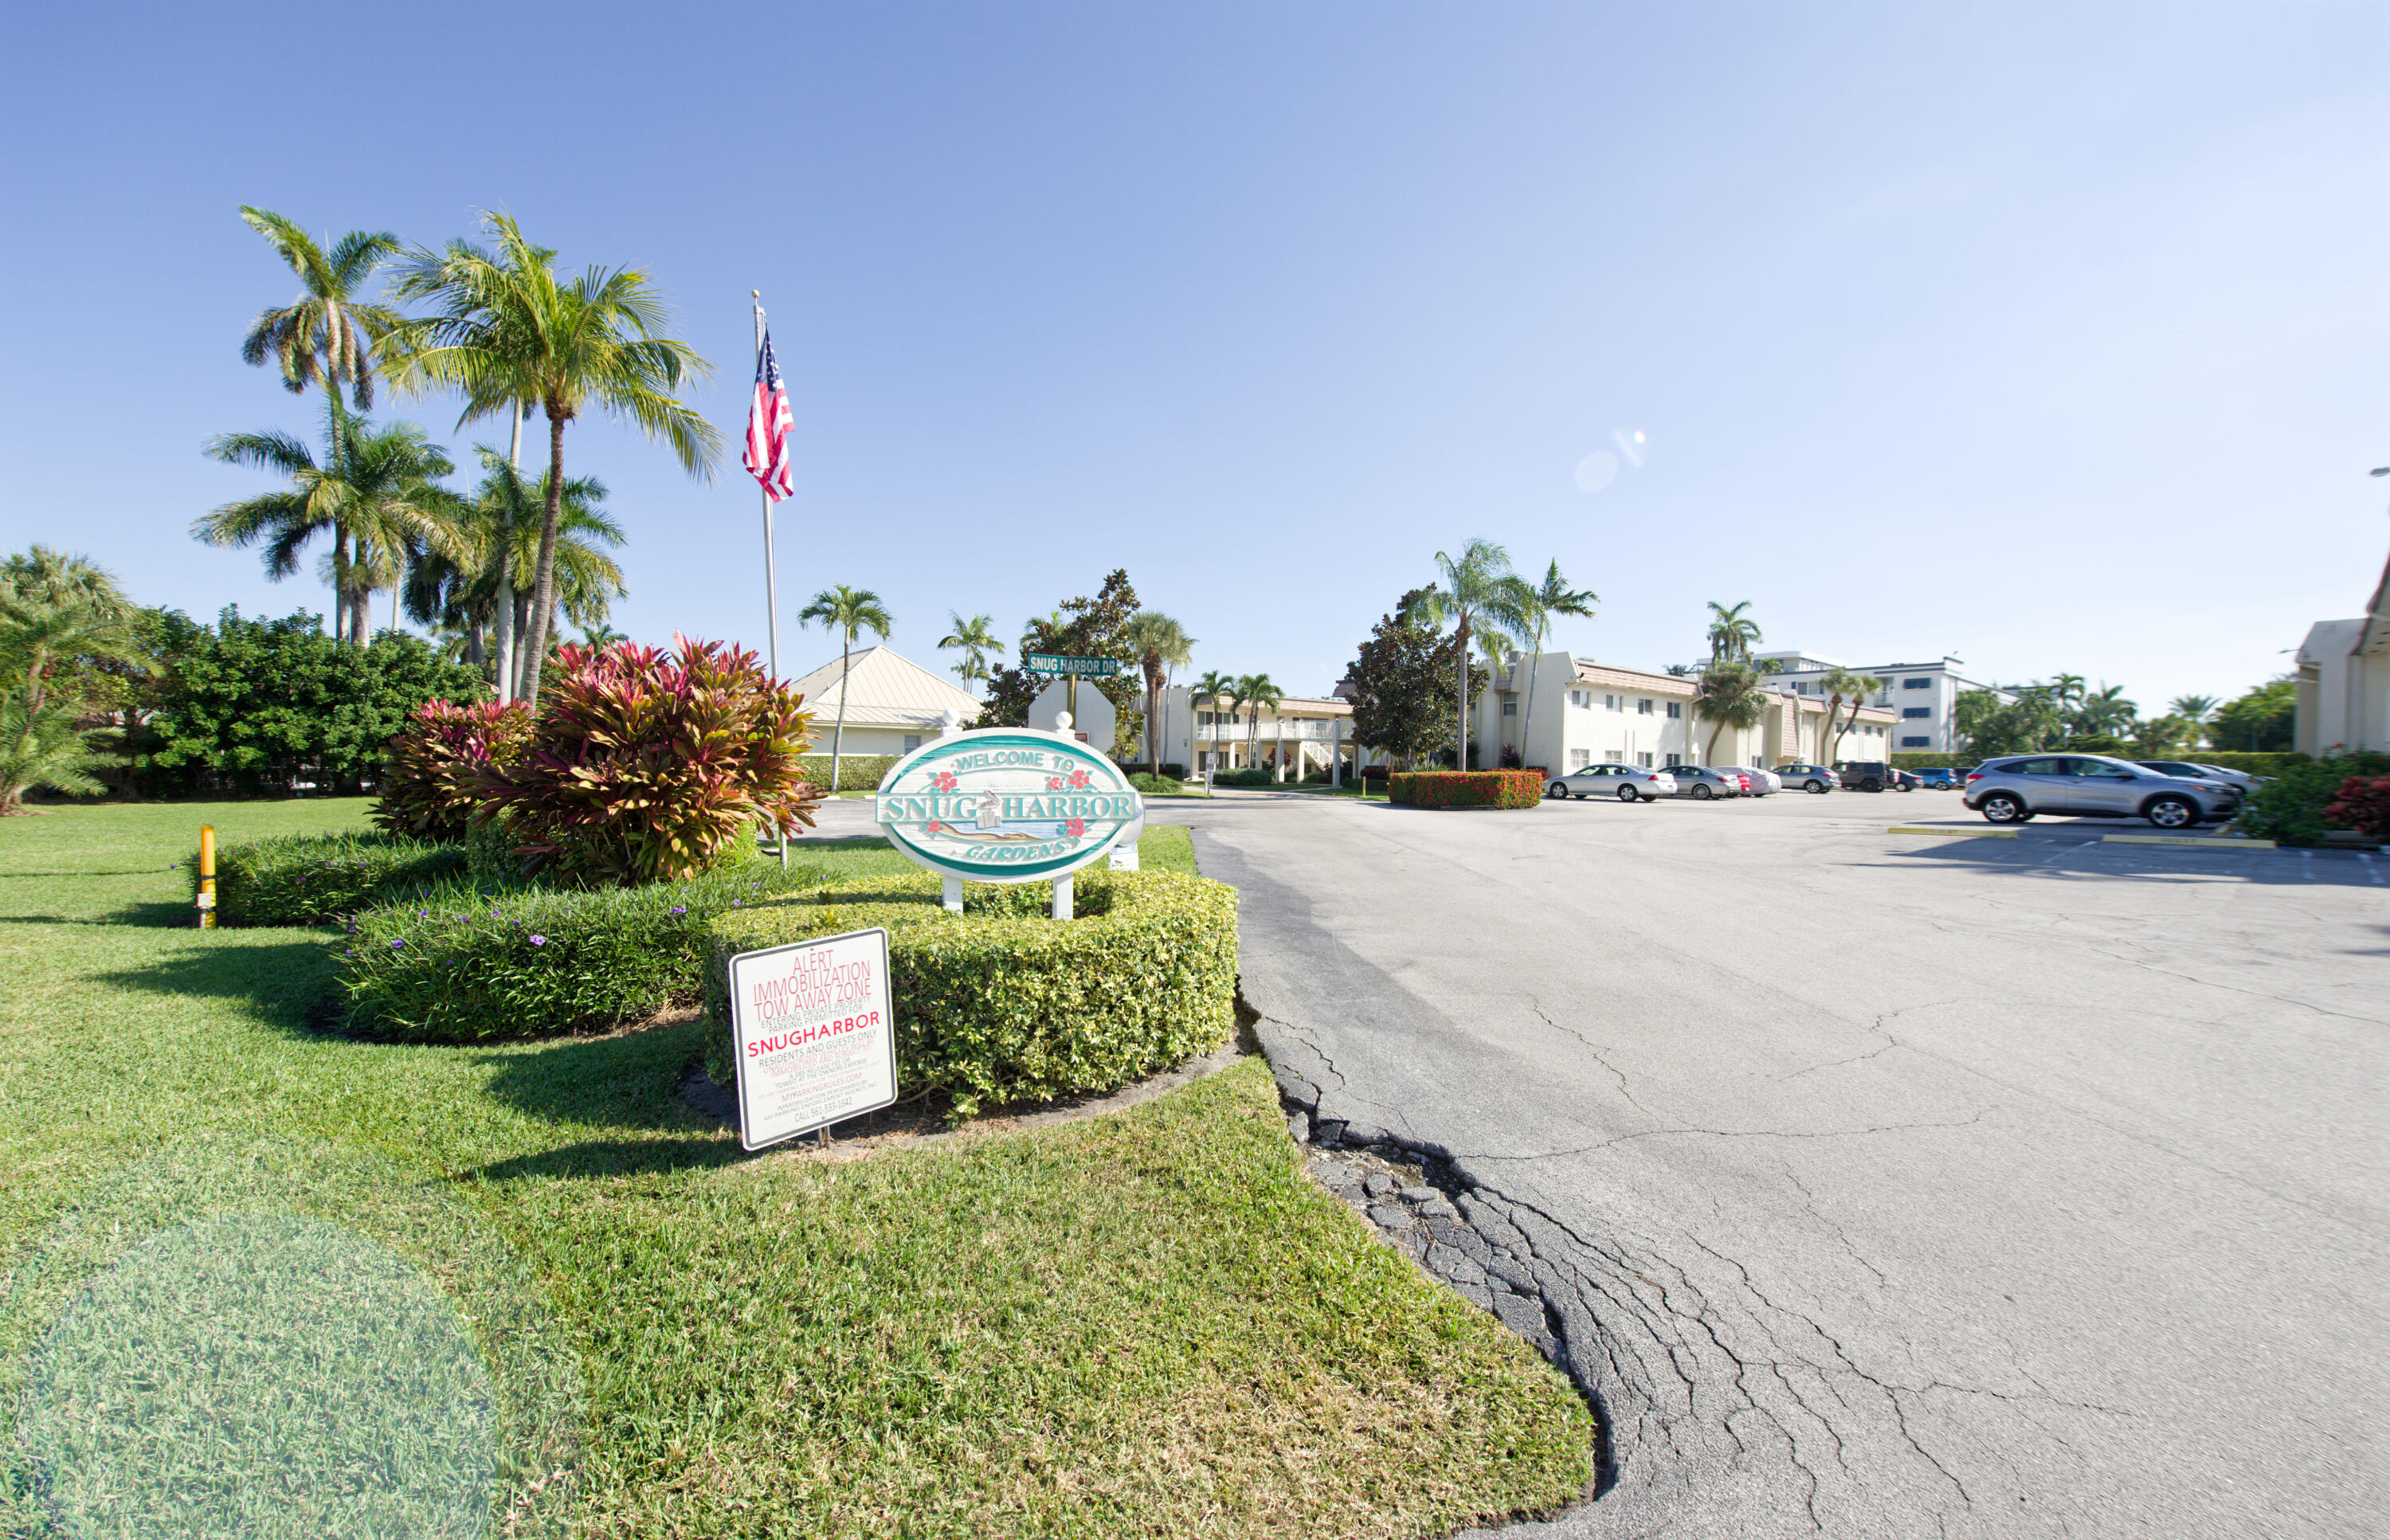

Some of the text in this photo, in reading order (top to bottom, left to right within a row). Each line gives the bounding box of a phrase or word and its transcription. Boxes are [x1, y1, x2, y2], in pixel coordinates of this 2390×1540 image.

[1030, 656, 1115, 673] SNUG HARBOR DR
[955, 751, 1075, 770] WELCOME TO
[887, 796, 1130, 819] SNUG HARBOR
[965, 841, 1066, 860] GARDENS
[793, 950, 834, 975] ALERT
[754, 960, 871, 1003] IMMOBILIZATION
[754, 978, 872, 1022] TOW AWAY ZONE
[761, 995, 871, 1029] ENTERING PRIVATE PROPERTY
[769, 1004, 864, 1034] PARKING PERMITTED FOR
[747, 1011, 880, 1059] SNUGHARBOR
[759, 1029, 877, 1068] RESIDENTS AND GUESTS ONLY
[795, 1097, 852, 1123] CALL 561-533-1642
